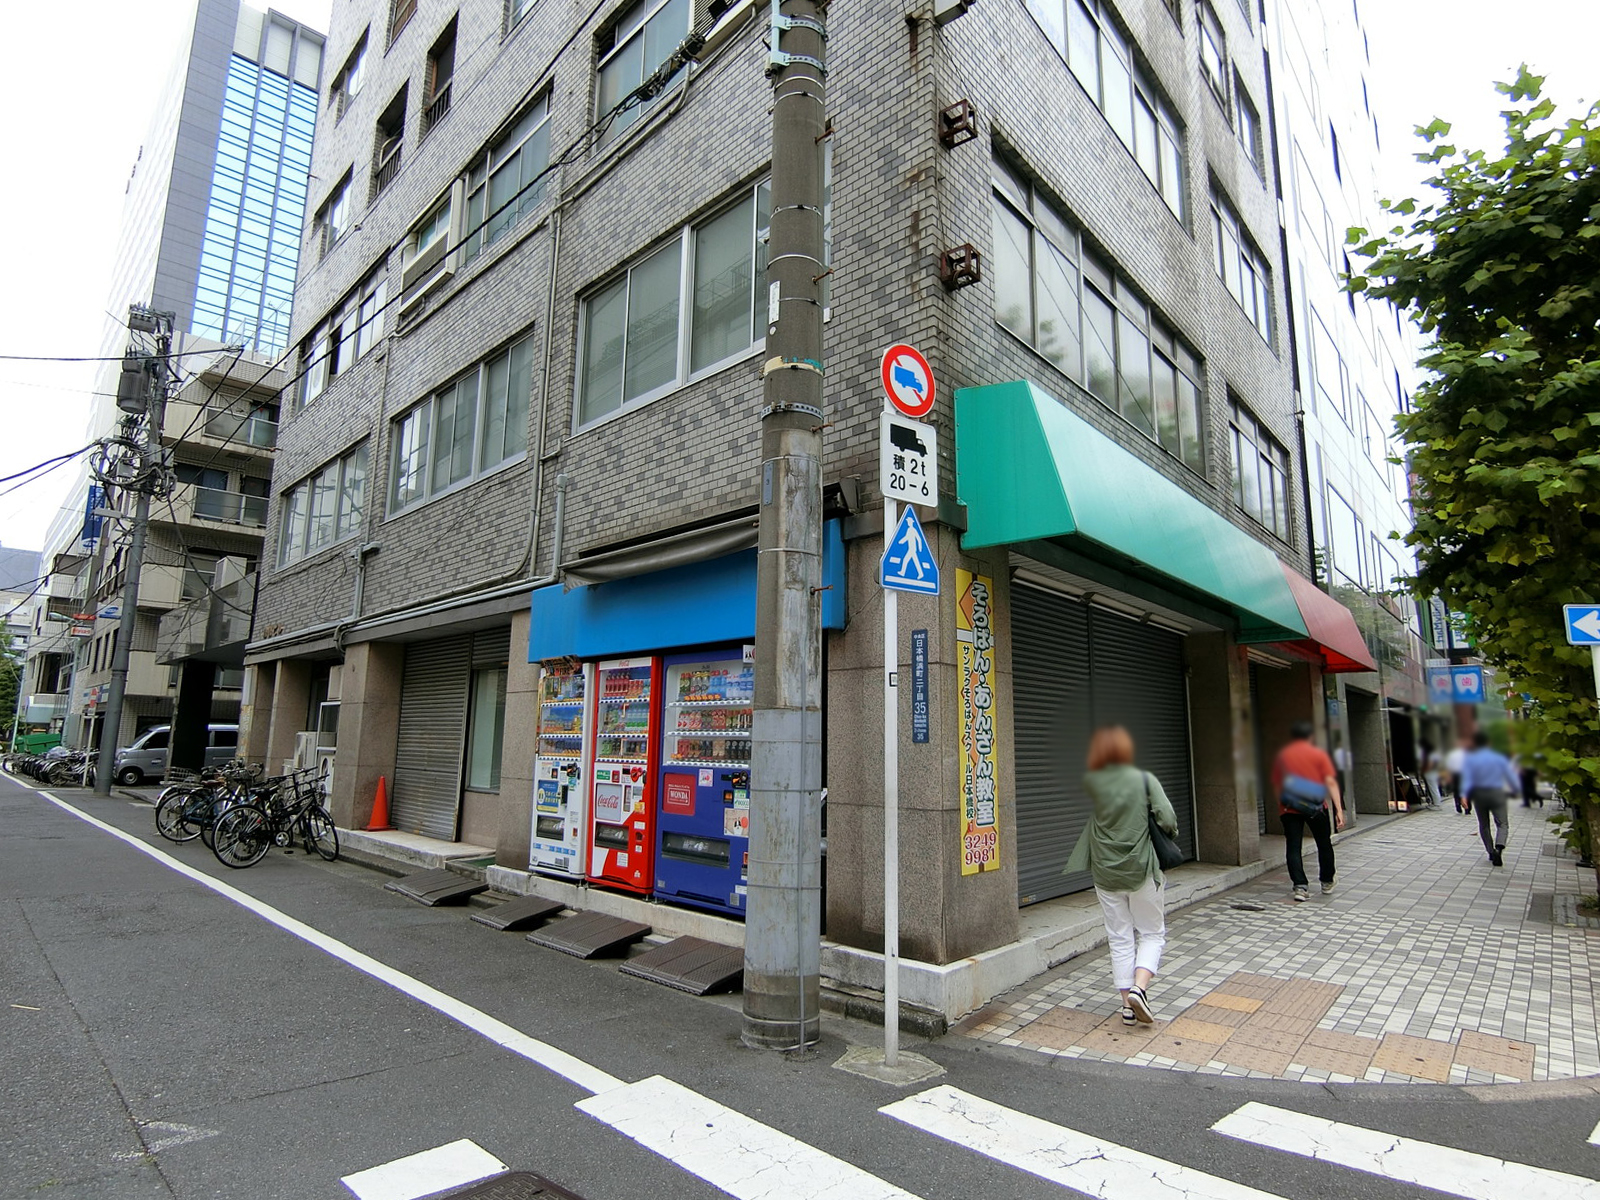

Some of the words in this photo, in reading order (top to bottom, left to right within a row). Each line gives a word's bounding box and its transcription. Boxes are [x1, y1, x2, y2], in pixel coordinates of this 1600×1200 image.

[914, 702, 926, 714] 35
[972, 581, 995, 826] そろばん・あんざん教室
[965, 832, 996, 850] 3249
[965, 847, 995, 865] 9981
